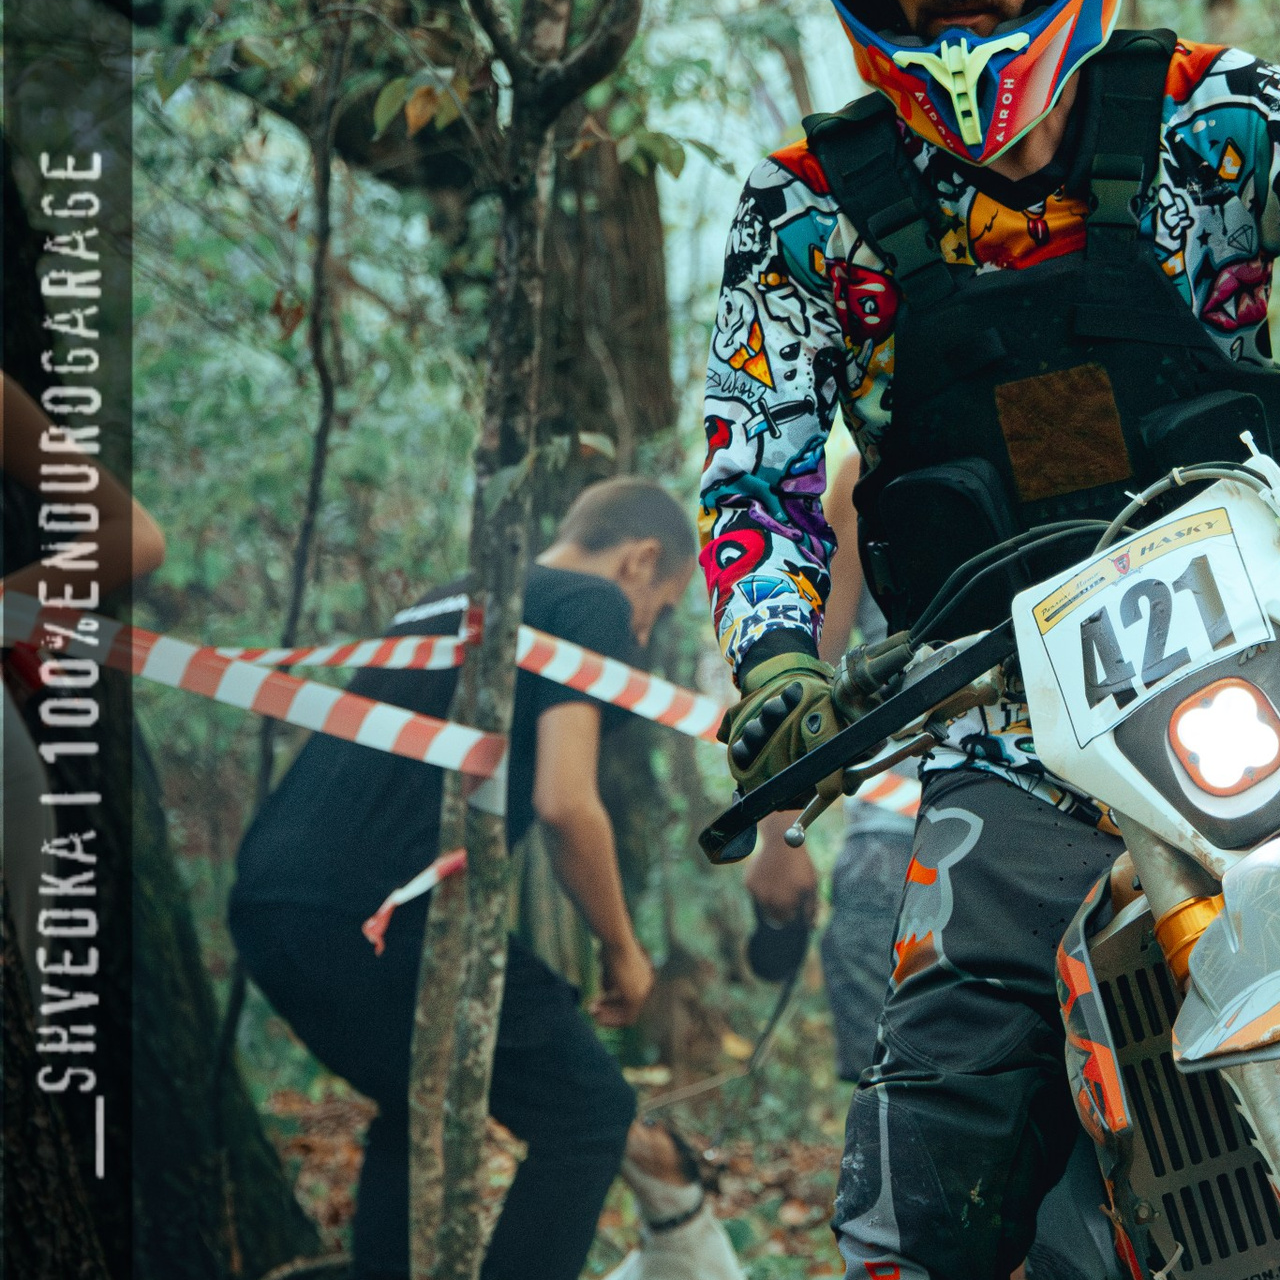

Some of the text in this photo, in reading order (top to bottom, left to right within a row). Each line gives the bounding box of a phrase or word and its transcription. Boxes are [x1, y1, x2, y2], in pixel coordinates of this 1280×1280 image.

[995, 78, 1015, 143] AIROH
[1139, 519, 1220, 557] HASKY
[1080, 554, 1238, 711] 421
